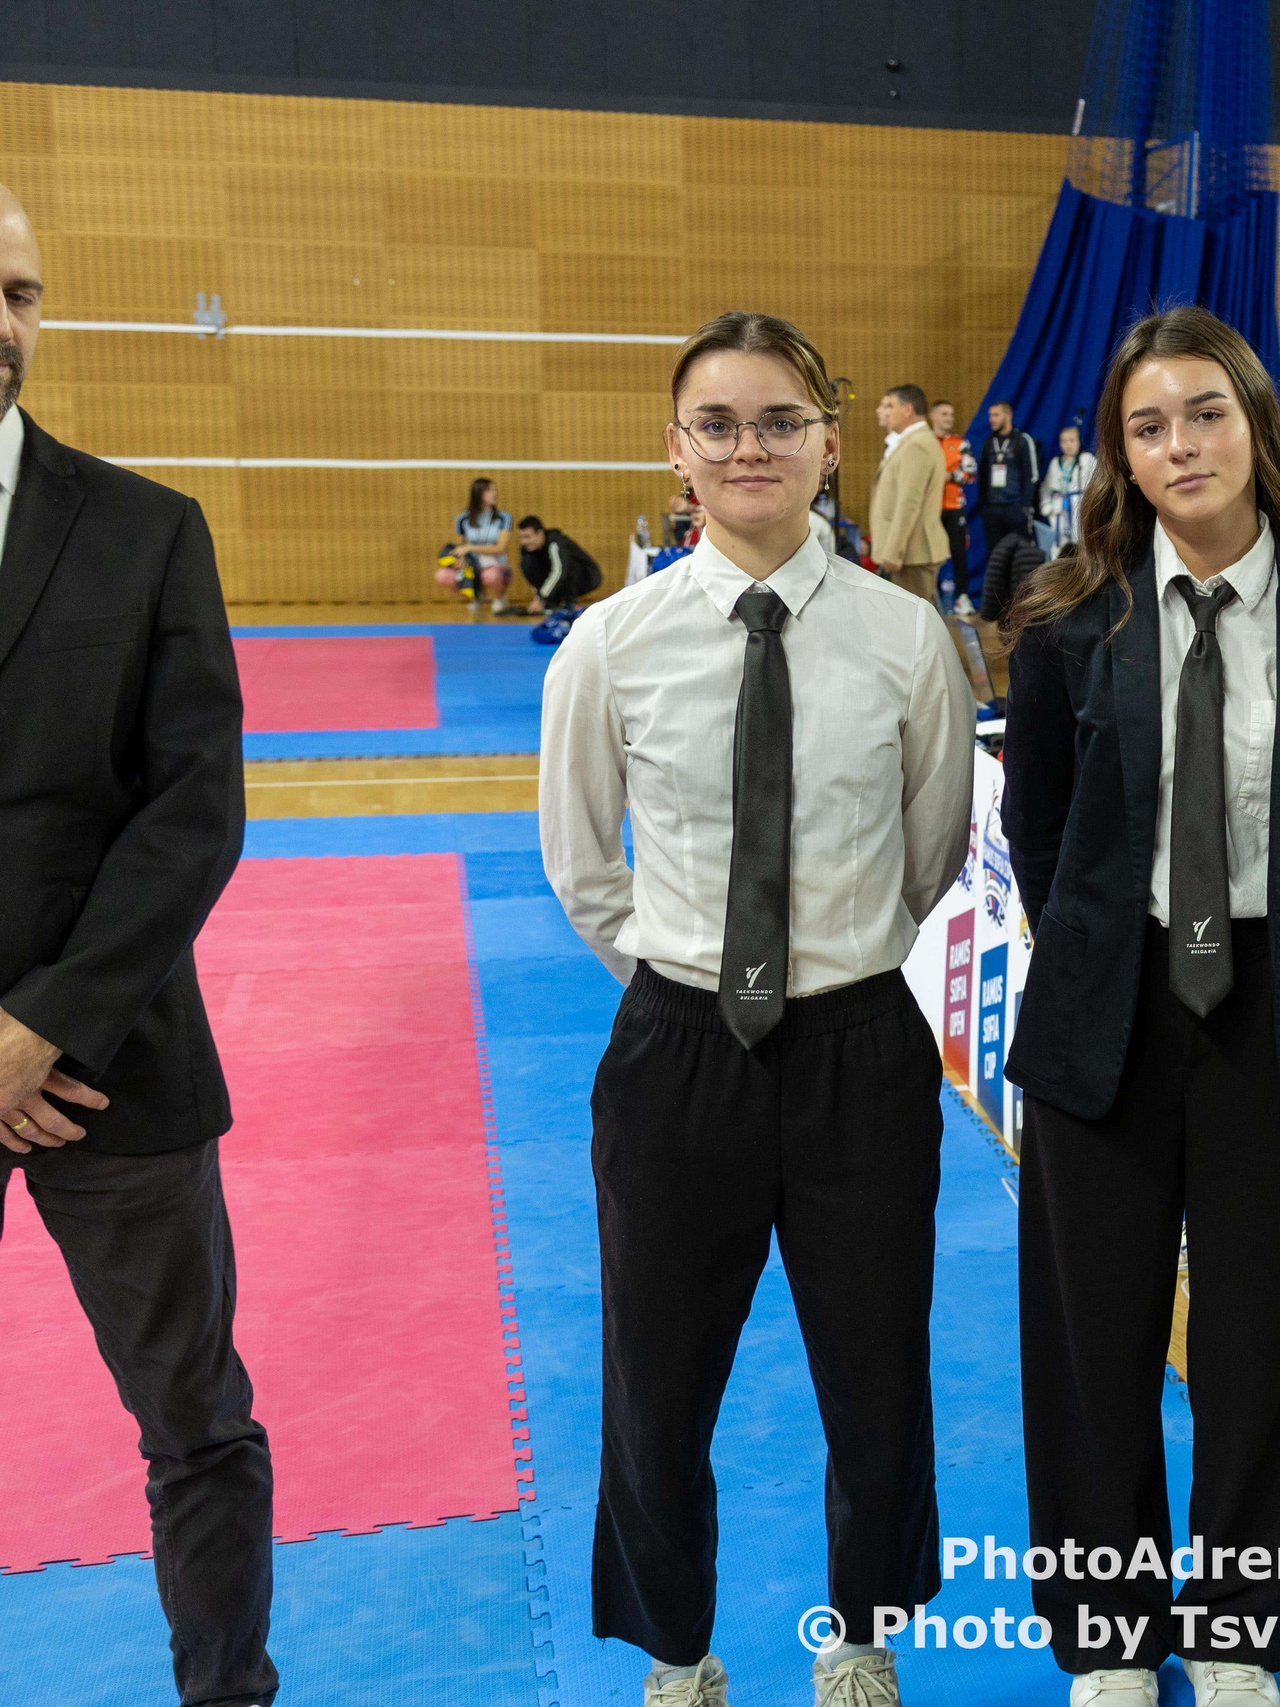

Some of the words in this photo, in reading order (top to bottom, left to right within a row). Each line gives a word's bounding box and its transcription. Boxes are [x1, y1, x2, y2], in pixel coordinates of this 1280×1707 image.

[949, 938, 971, 970] RAMUS
[949, 974, 967, 1004] SOFIA
[981, 974, 1003, 1008] RAMUS
[949, 1009, 966, 1037] OPEN
[982, 1013, 1000, 1044] SOFIA
[983, 1051, 997, 1080] CUP
